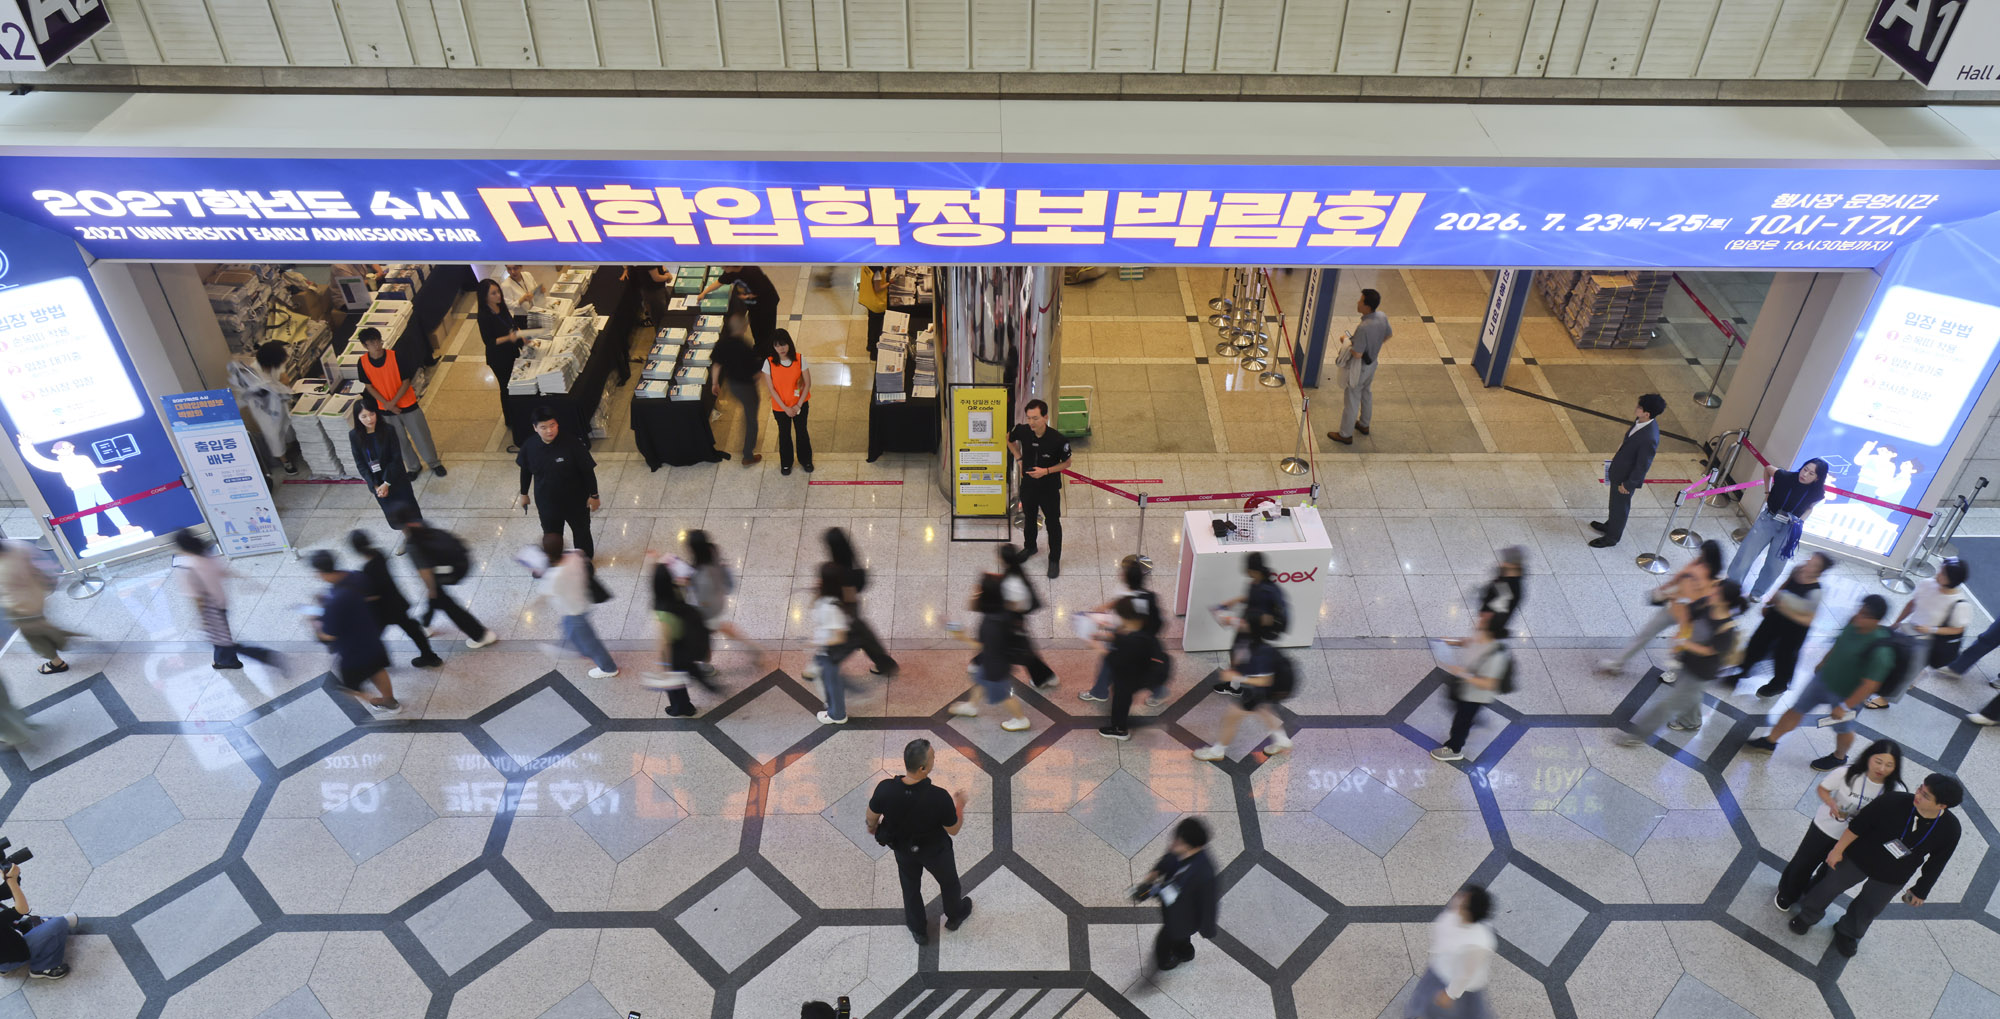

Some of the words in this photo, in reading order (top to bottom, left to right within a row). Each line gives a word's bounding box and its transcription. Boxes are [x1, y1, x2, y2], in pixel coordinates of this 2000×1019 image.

[1879, 0, 1962, 63] A1
[1956, 65, 1994, 81] Hall
[32, 189, 360, 219] 2027학년도
[370, 190, 470, 220] 수시
[1771, 193, 1844, 209] 행사장
[1842, 193, 1940, 210] 운영시간
[477, 184, 1427, 248] 대학입학정보박람회
[1434, 211, 1527, 232] 2026.
[1540, 212, 1566, 232] 7.
[1744, 214, 1923, 236] 10시-17시
[74, 226, 128, 240] 2027
[127, 226, 248, 241] UNIVERSITY
[247, 227, 309, 241] EARLY
[311, 227, 434, 242] ADMISSIONS
[432, 228, 481, 243] FAIR
[1724, 239, 1781, 251] (입장은
[1783, 240, 1893, 252] 16시30분까지)
[29, 303, 66, 324] 방법
[1904, 311, 1937, 331] 입장
[1939, 319, 1974, 339] 방법
[194, 437, 237, 453] 출입증
[207, 452, 236, 465] 배부
[1268, 567, 1318, 583] coex
